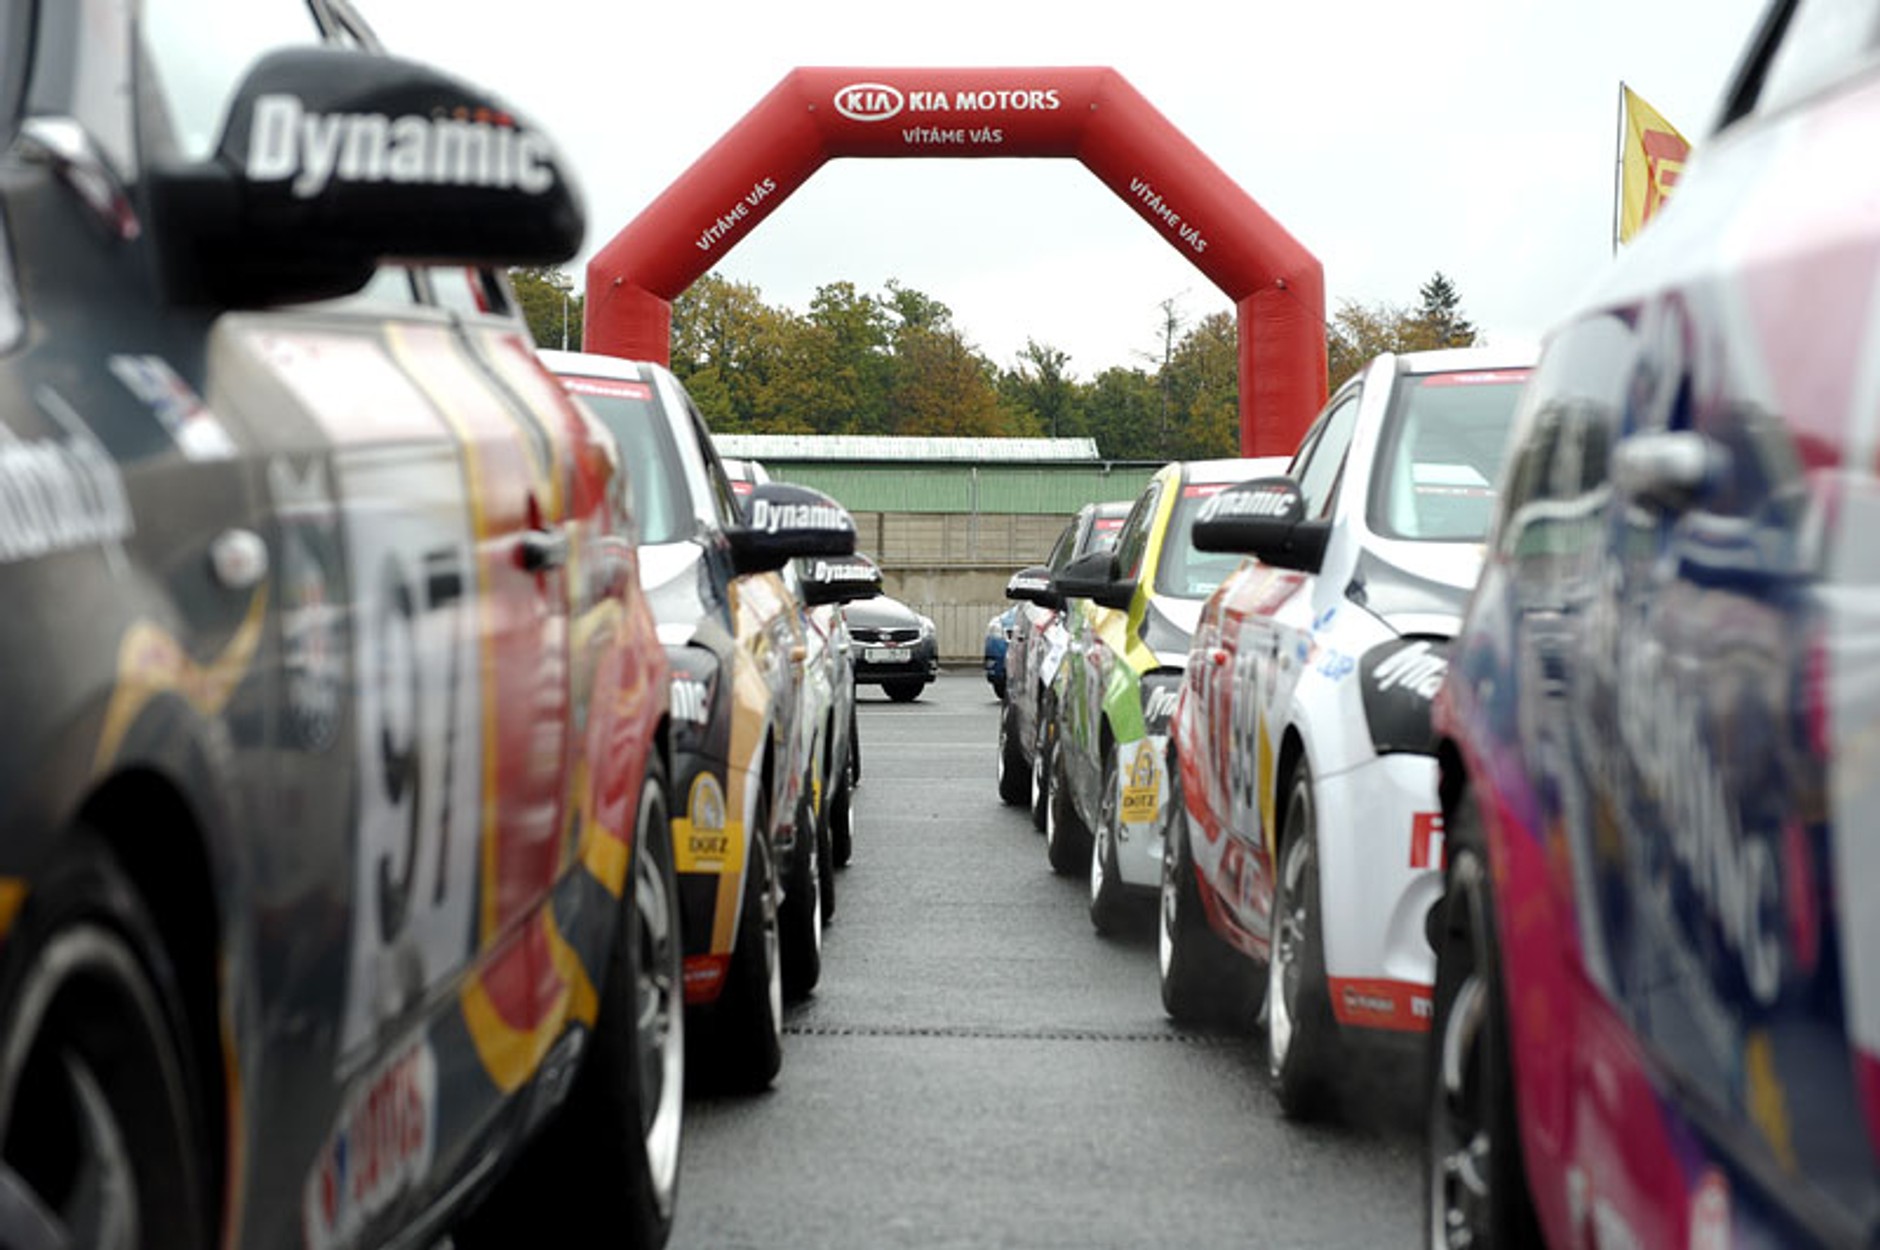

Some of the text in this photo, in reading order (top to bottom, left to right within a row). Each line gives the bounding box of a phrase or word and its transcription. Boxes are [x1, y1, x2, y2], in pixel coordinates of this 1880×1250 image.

[847, 91, 892, 111] KIA
[909, 89, 1060, 111] KIA MOTORS
[246, 93, 553, 199] Dynamic
[902, 126, 1003, 143] VÍTÁME VÁS
[695, 177, 777, 251] VÍTÁME VÁS
[1130, 177, 1208, 253] VÍTÁME VÁS
[751, 499, 849, 534] Dynamic
[815, 561, 878, 583] Dynamic
